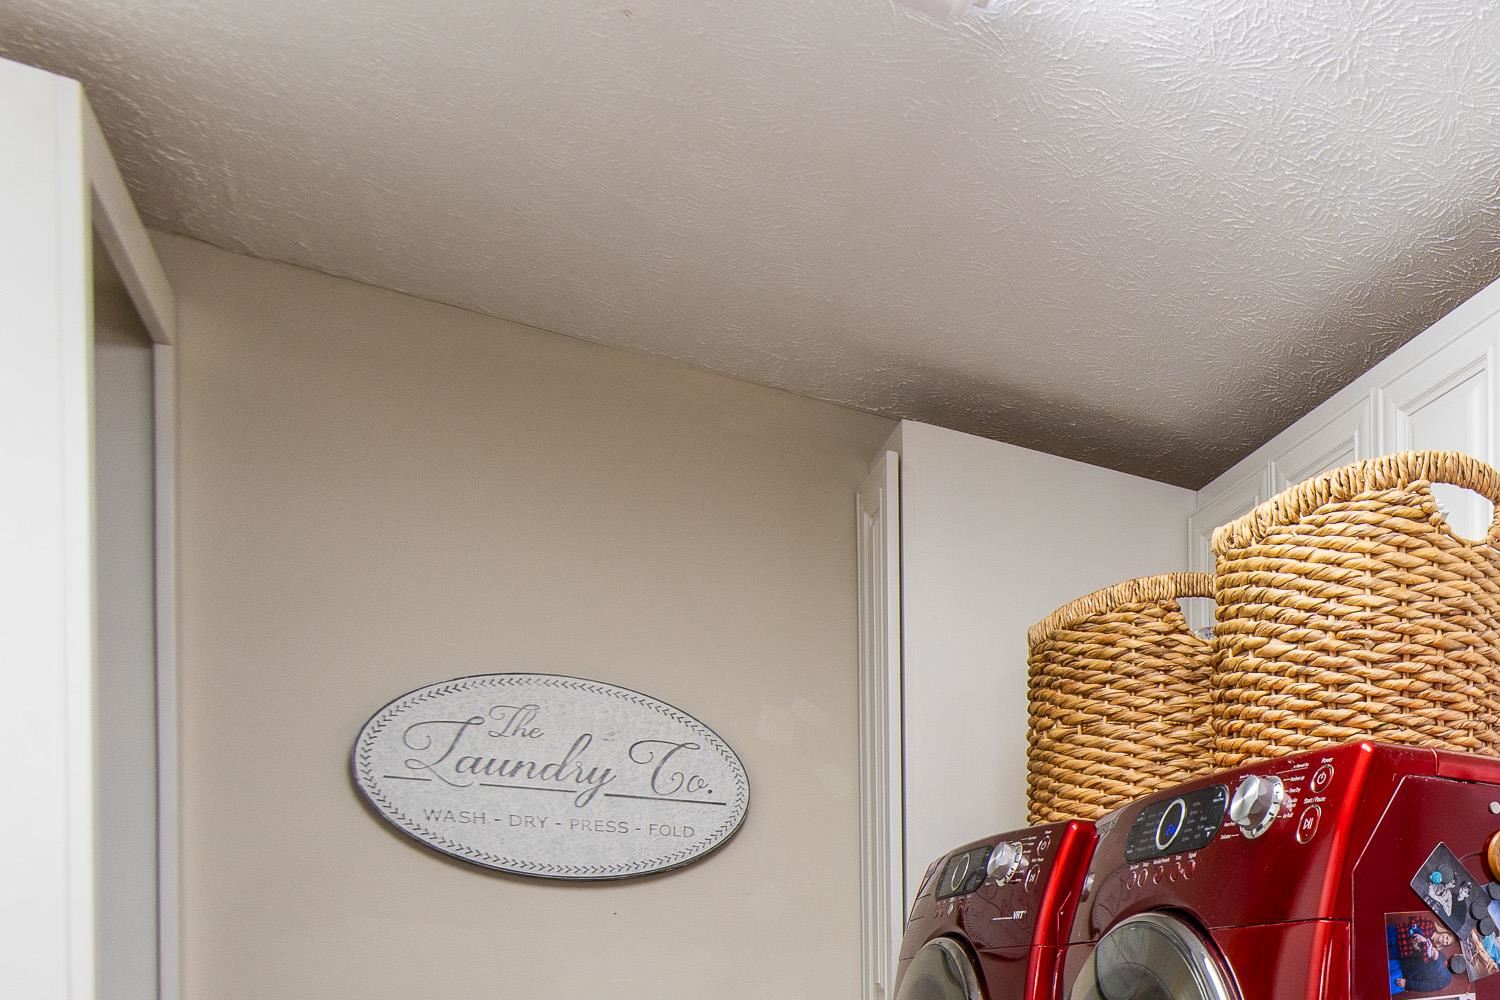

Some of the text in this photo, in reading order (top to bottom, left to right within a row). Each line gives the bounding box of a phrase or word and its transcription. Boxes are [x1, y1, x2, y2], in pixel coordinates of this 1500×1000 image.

[487, 704, 544, 739] The
[403, 716, 714, 808] Laundry Co.
[423, 808, 486, 825] WASH
[509, 814, 549, 829] DRY
[570, 818, 629, 834] PRESS
[649, 823, 695, 838] FOLD
